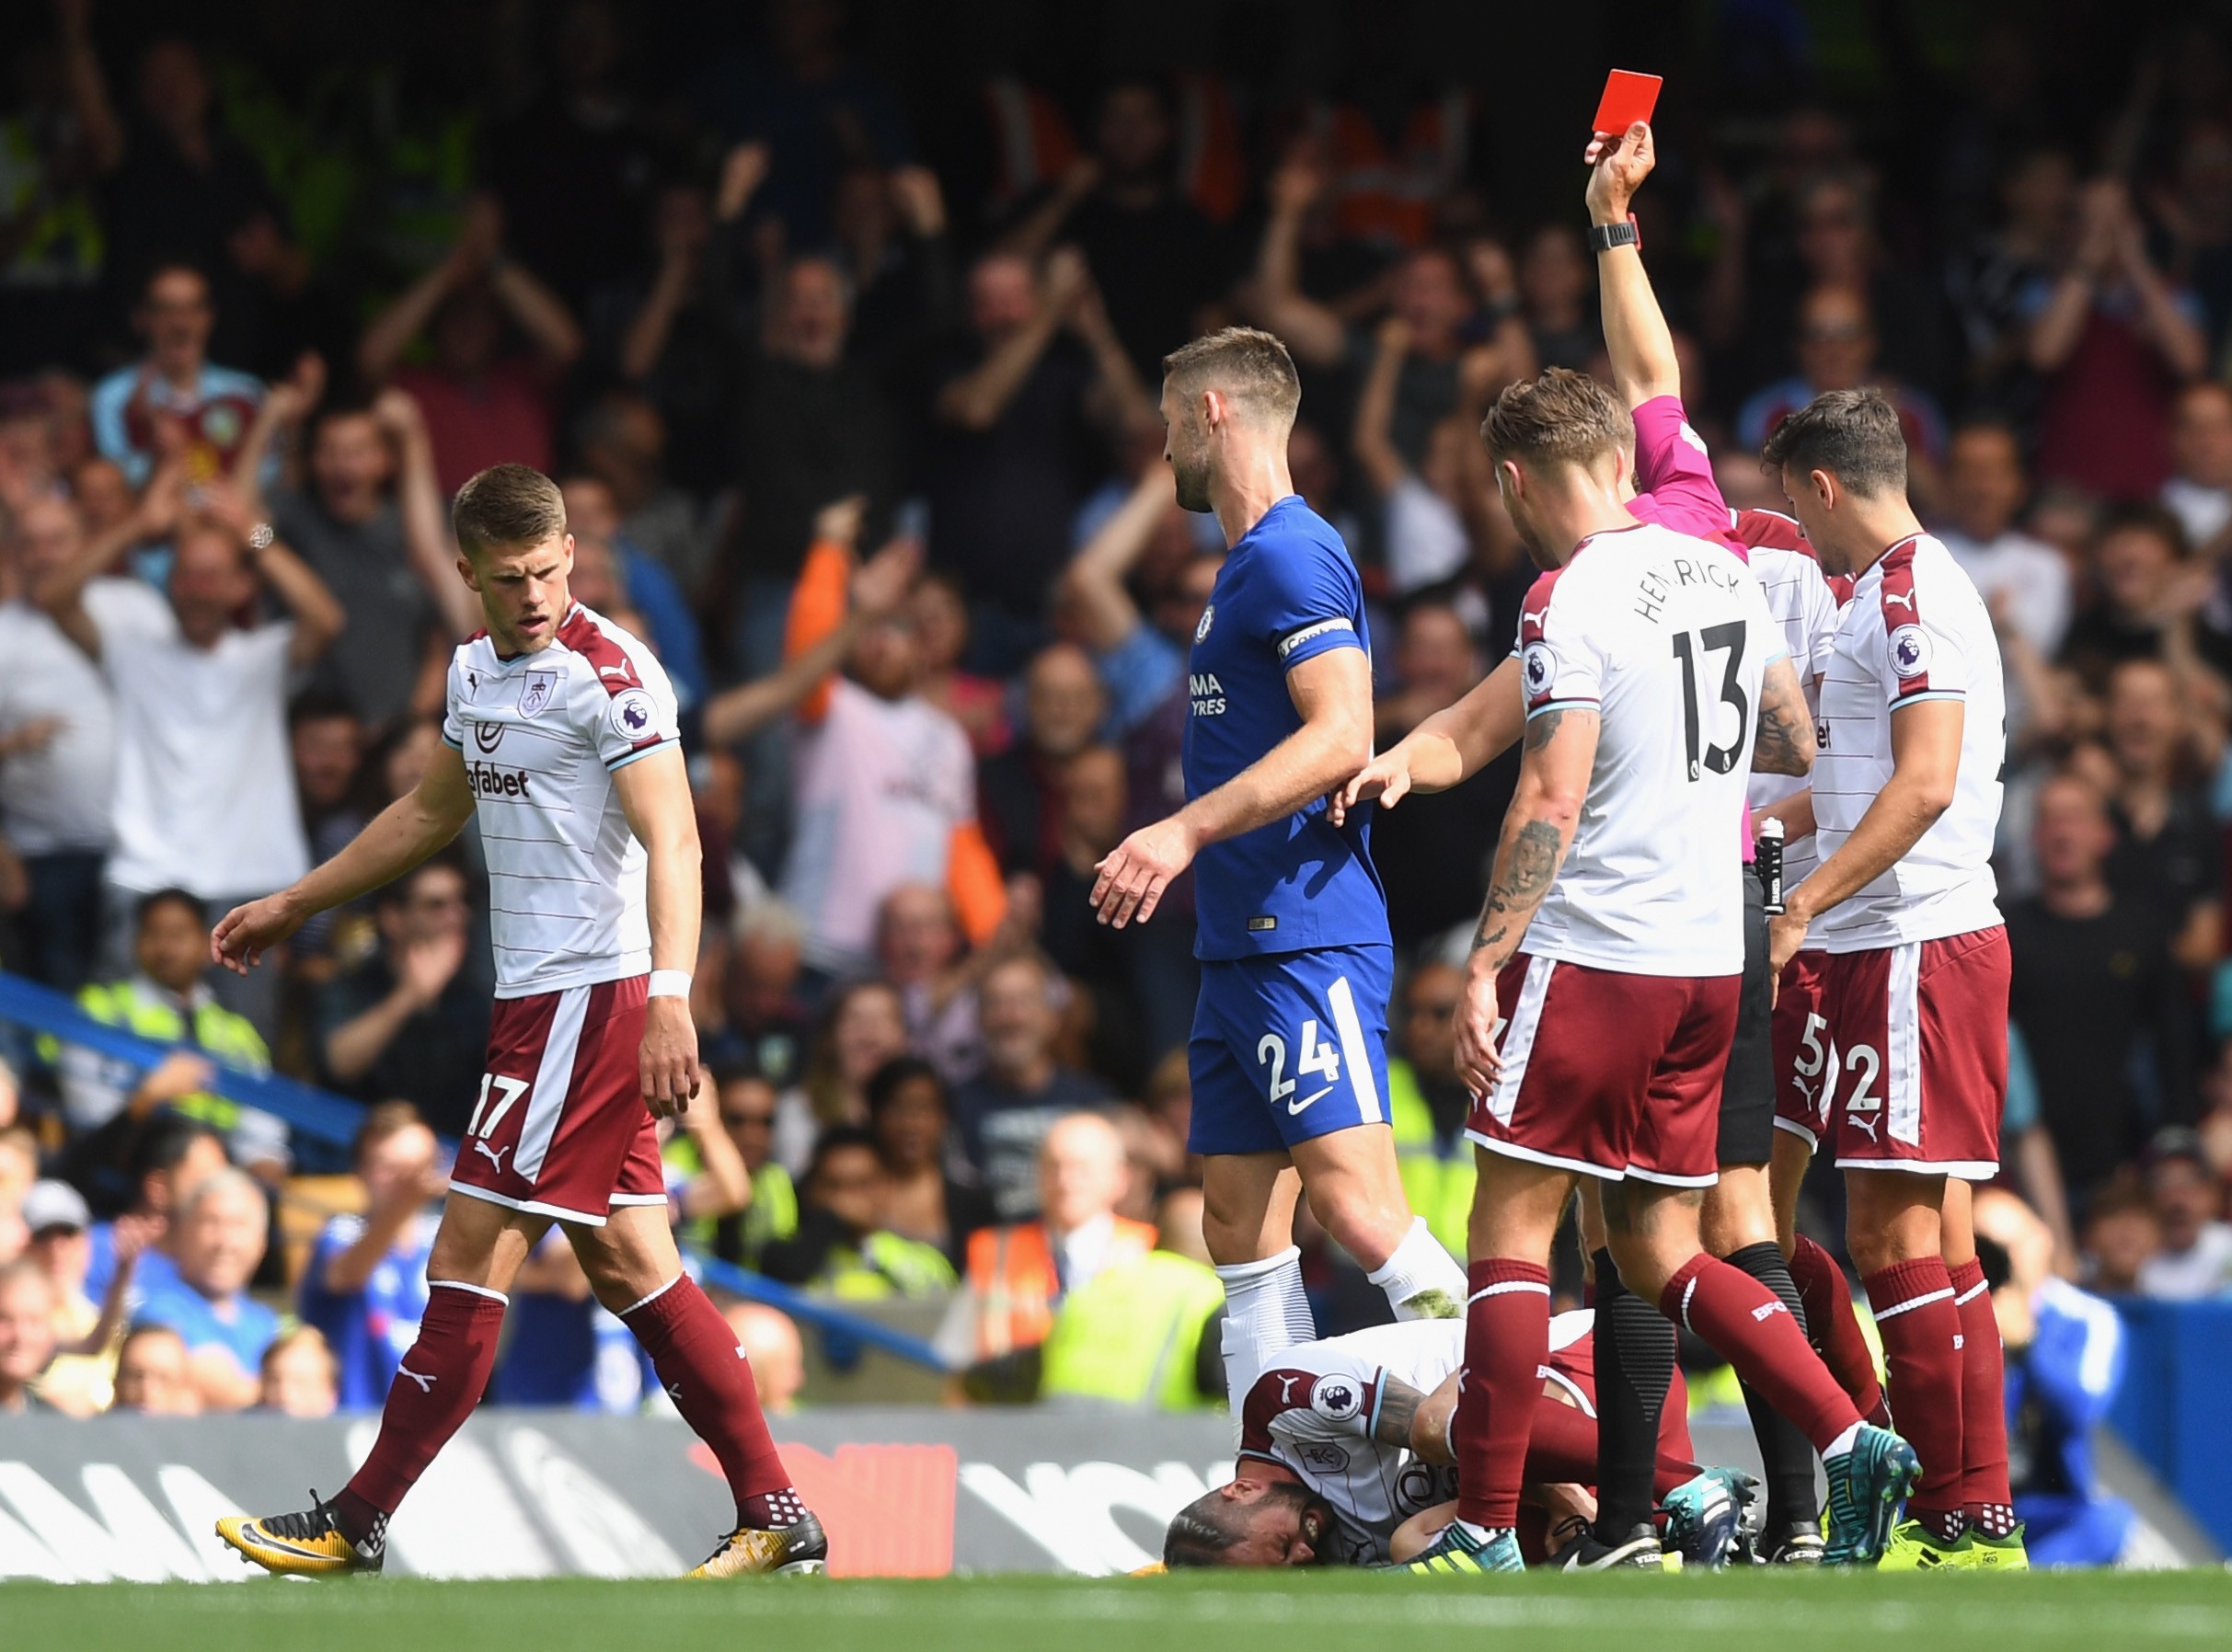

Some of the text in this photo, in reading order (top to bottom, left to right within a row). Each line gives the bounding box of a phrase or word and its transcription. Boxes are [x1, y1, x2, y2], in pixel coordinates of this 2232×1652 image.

[1634, 559, 1740, 624] HENRICK
[1672, 620, 1747, 782] 13
[466, 760, 530, 798] afabet
[1257, 1019, 1340, 1104] 24
[1793, 1012, 1828, 1077] 5
[1846, 1044, 1881, 1111] 2
[466, 1073, 530, 1140] 17
